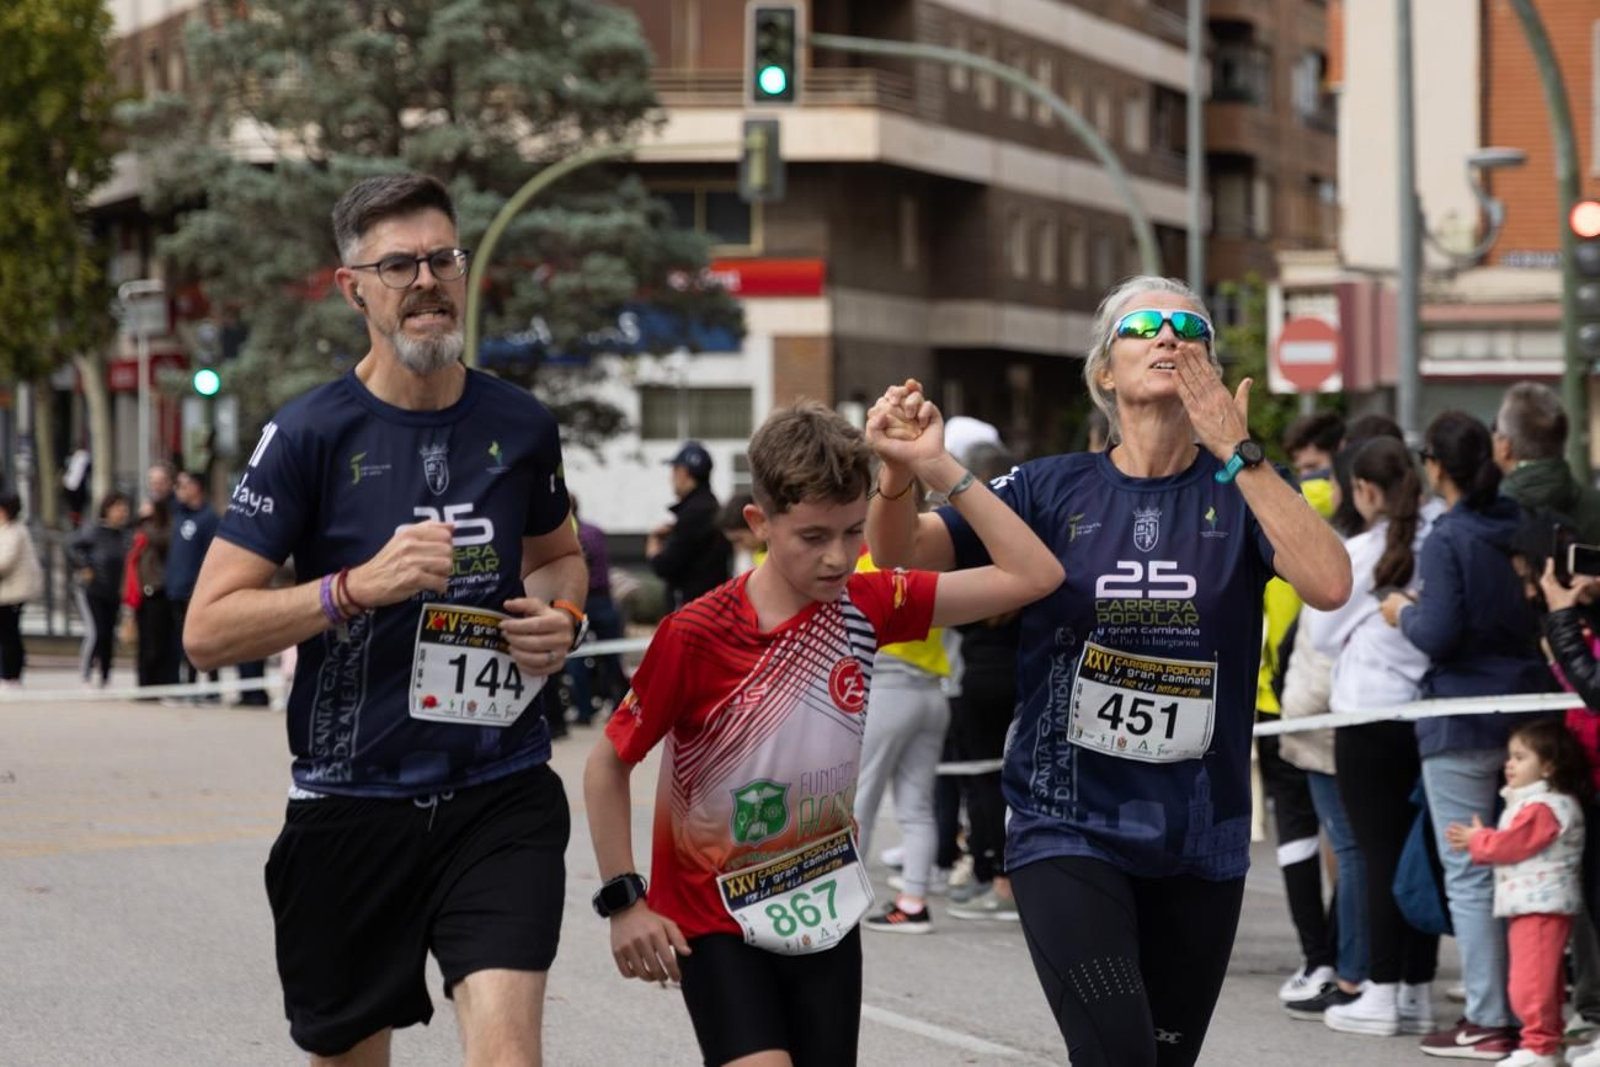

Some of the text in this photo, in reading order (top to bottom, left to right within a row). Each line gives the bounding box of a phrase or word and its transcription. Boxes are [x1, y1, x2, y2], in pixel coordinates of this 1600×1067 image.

[1095, 560, 1197, 599] 25
[1095, 599, 1197, 612] CARRERA
[1096, 612, 1200, 626] POPULAR
[473, 624, 498, 636] gran
[1108, 627, 1137, 637] gran
[1140, 626, 1200, 637] caminata
[449, 653, 525, 700] 144
[1084, 648, 1212, 678] XXV CARRERA POPULAR
[1114, 666, 1211, 686] y gran caminata
[314, 698, 334, 758] SANTA
[1096, 692, 1179, 740] 451
[332, 732, 352, 759] DE
[1035, 743, 1051, 798] SANTA
[1054, 776, 1070, 801] DE
[726, 873, 757, 900] XXV
[757, 855, 803, 879] CARRERA
[804, 835, 848, 862] POPULAR
[759, 879, 766, 888] y
[772, 867, 799, 883] gran
[803, 844, 849, 869] caminata
[765, 879, 838, 937] 867
